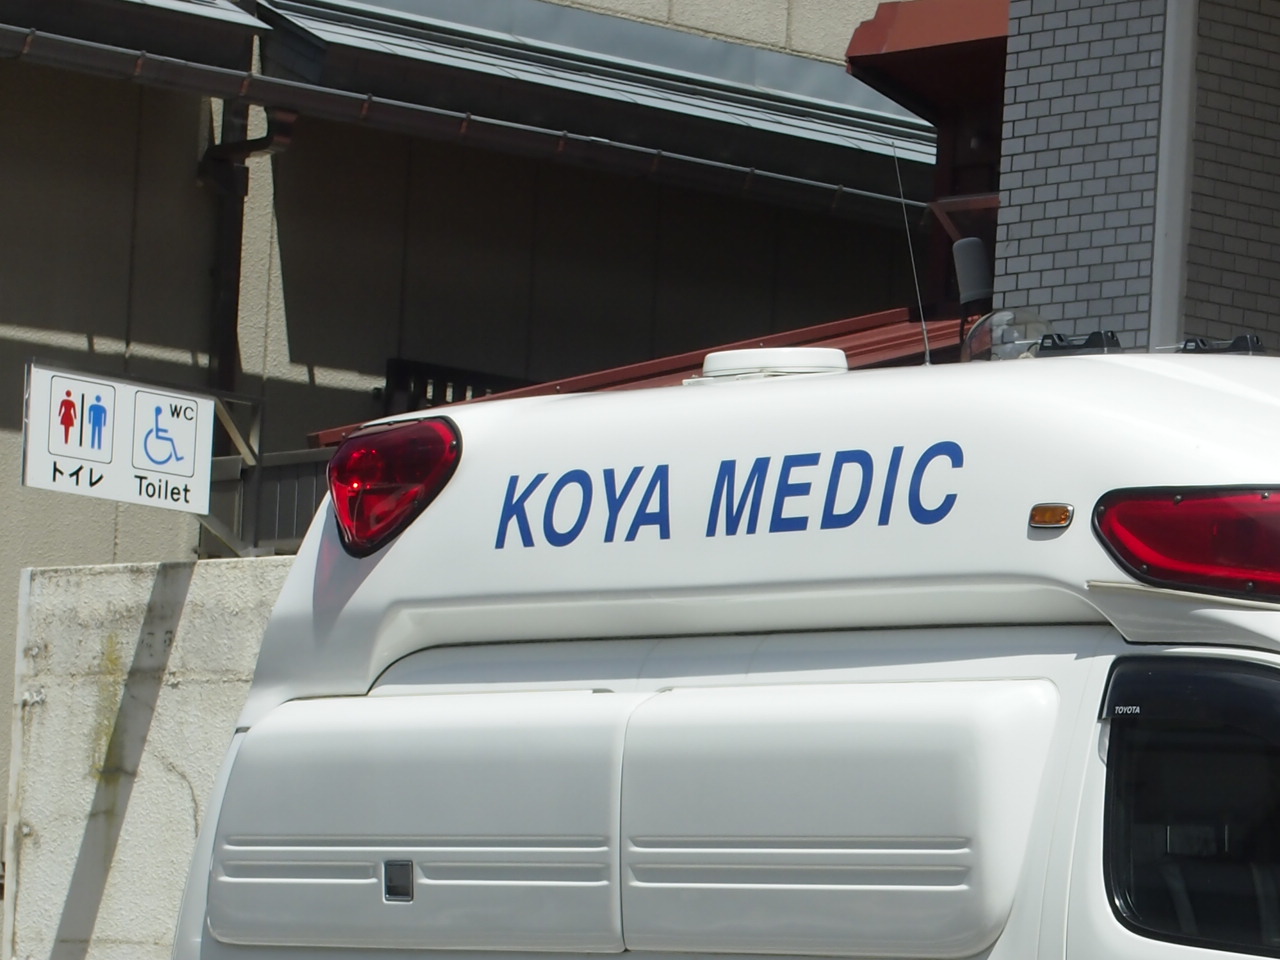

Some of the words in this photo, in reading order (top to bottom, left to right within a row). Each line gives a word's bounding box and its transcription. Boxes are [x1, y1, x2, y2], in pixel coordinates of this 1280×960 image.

[169, 403, 195, 421] WC
[52, 461, 104, 488] トイレ
[134, 475, 191, 504] Toilet
[494, 464, 672, 550] KOYA
[705, 440, 965, 538] MEDIC
[1114, 706, 1140, 714] TOYOTA
